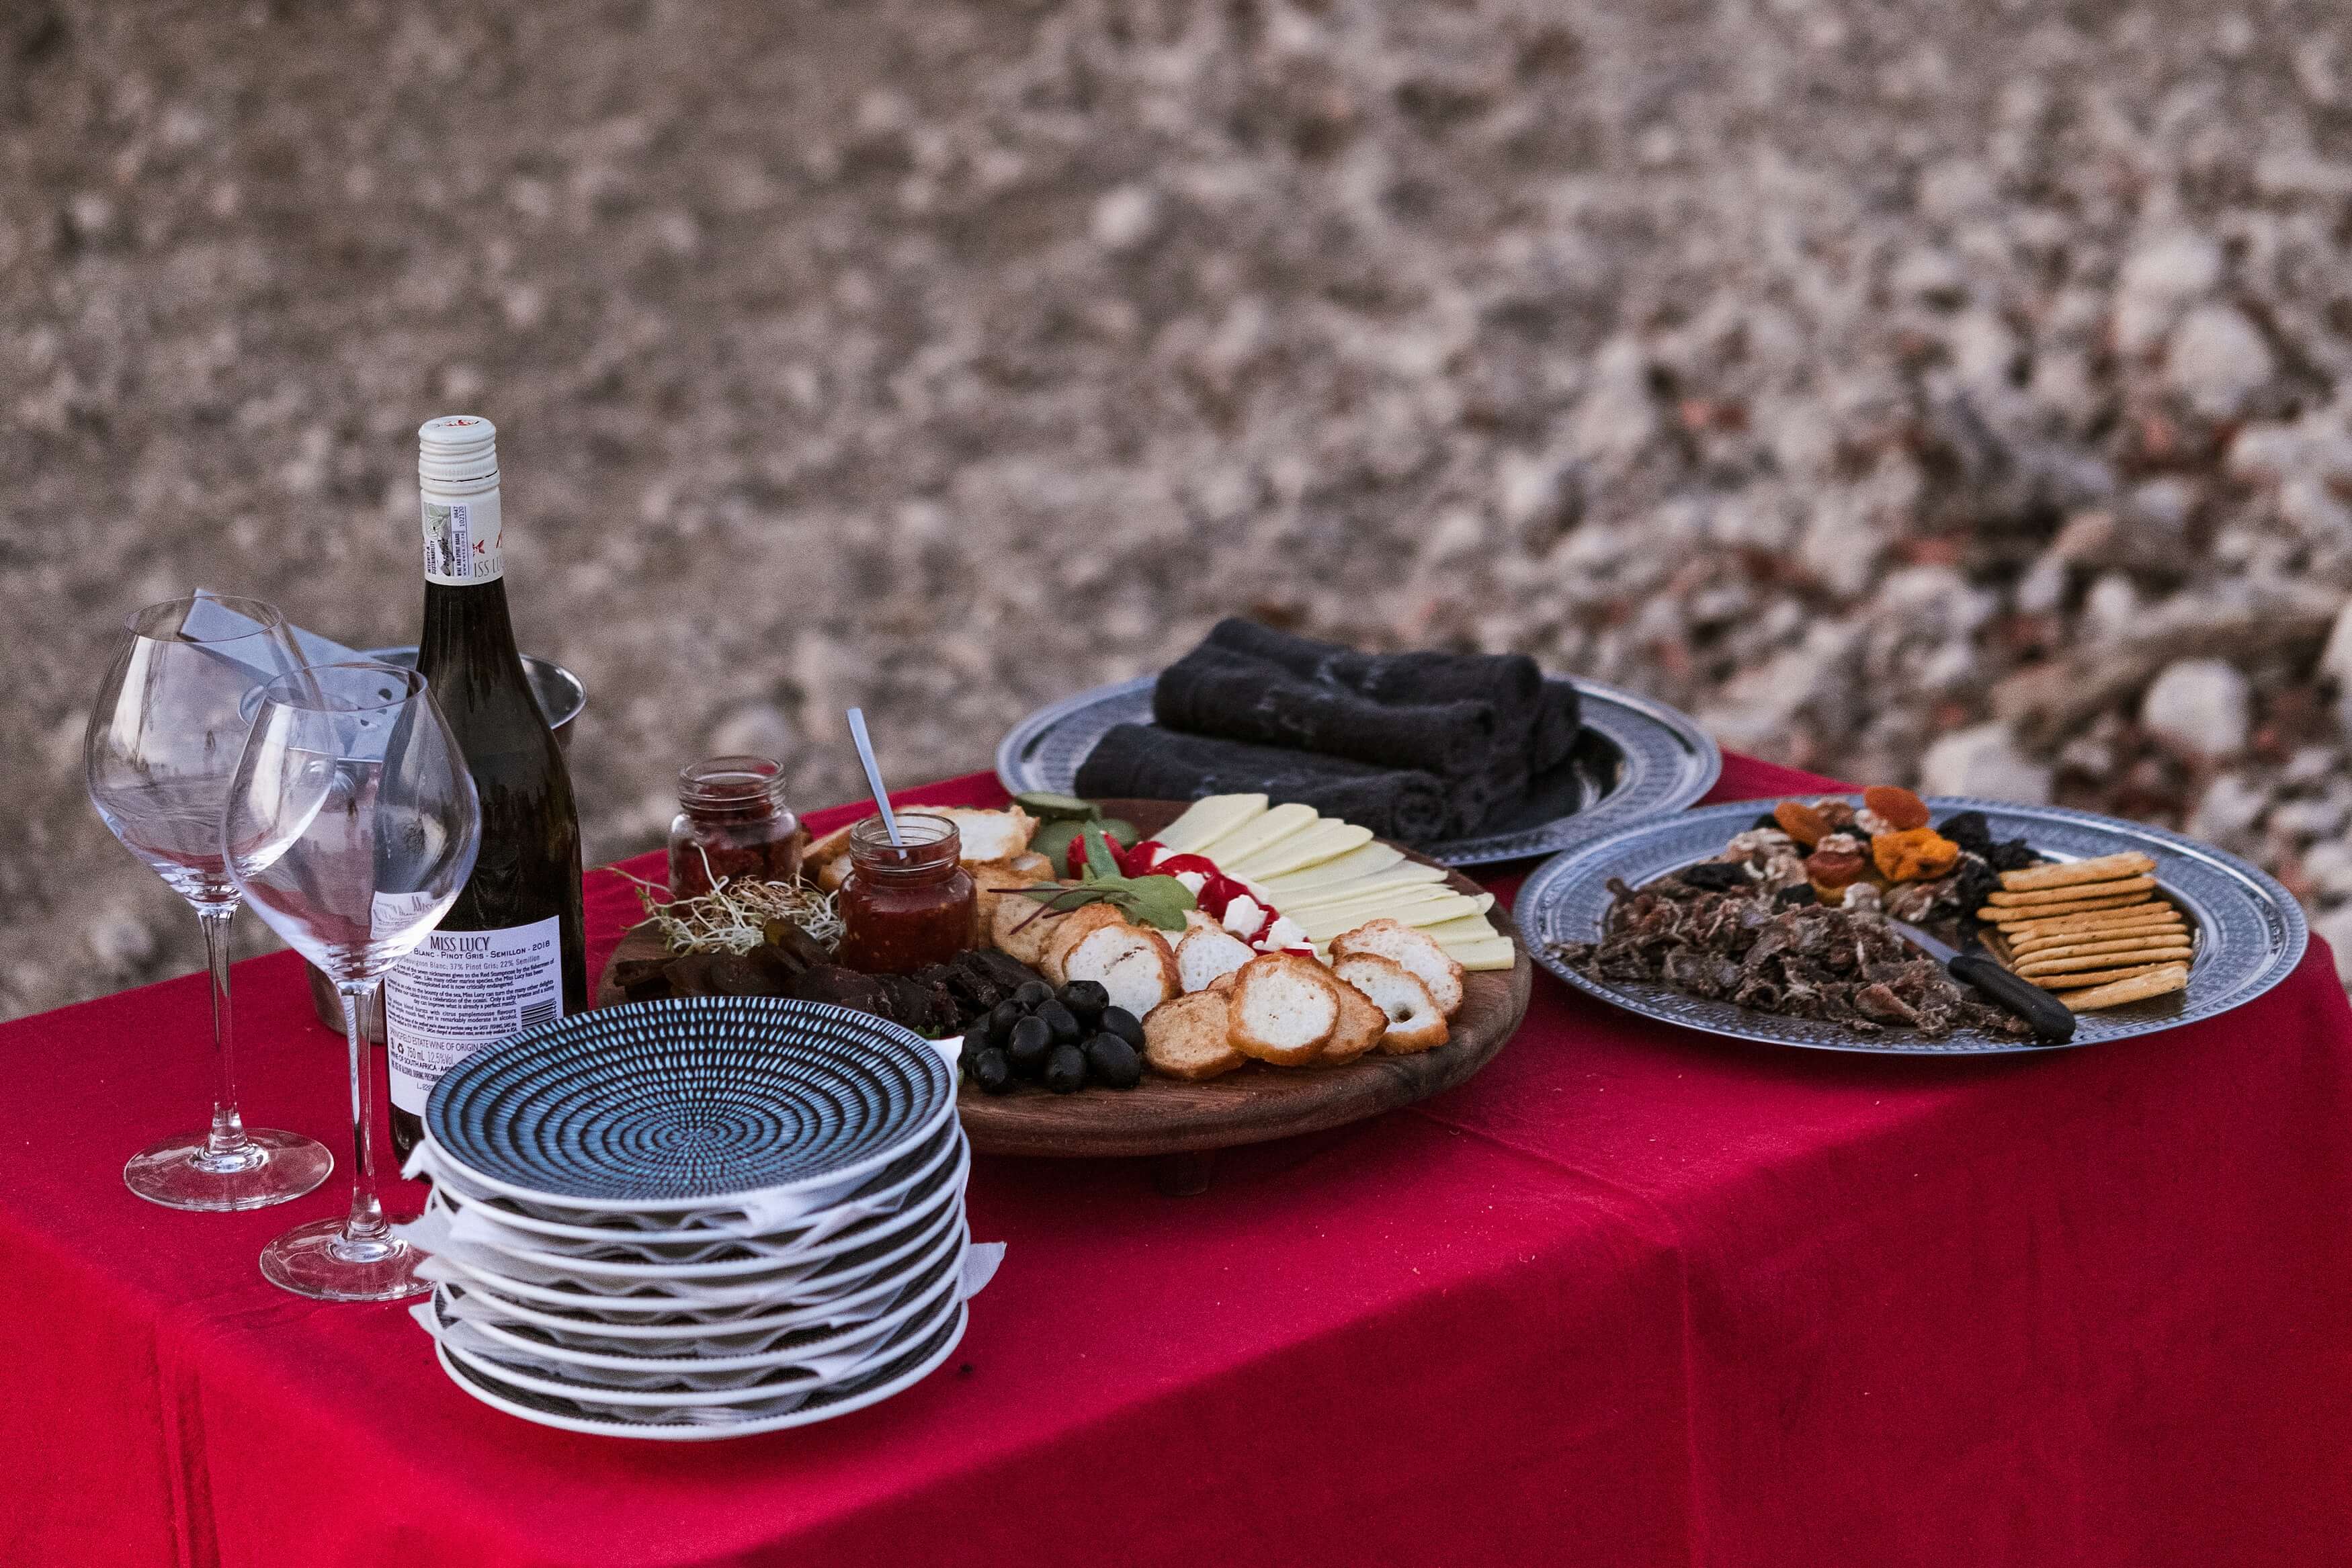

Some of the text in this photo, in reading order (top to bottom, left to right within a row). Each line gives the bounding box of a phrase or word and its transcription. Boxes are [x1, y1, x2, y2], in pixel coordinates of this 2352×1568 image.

[474, 560, 489, 577] ISS
[414, 948, 435, 957] BLANC
[491, 948, 526, 958] SEMILLON
[532, 940, 550, 951] 2018
[430, 936, 490, 952] MISS LUCY
[500, 960, 514, 968] 22%
[516, 955, 540, 965] Semillon
[412, 1037, 429, 1048] ESTATE
[430, 1041, 445, 1050] WINE
[446, 1043, 454, 1051] OF
[456, 1042, 478, 1051] ORIGIN
[419, 1062, 437, 1072] AFRICA
